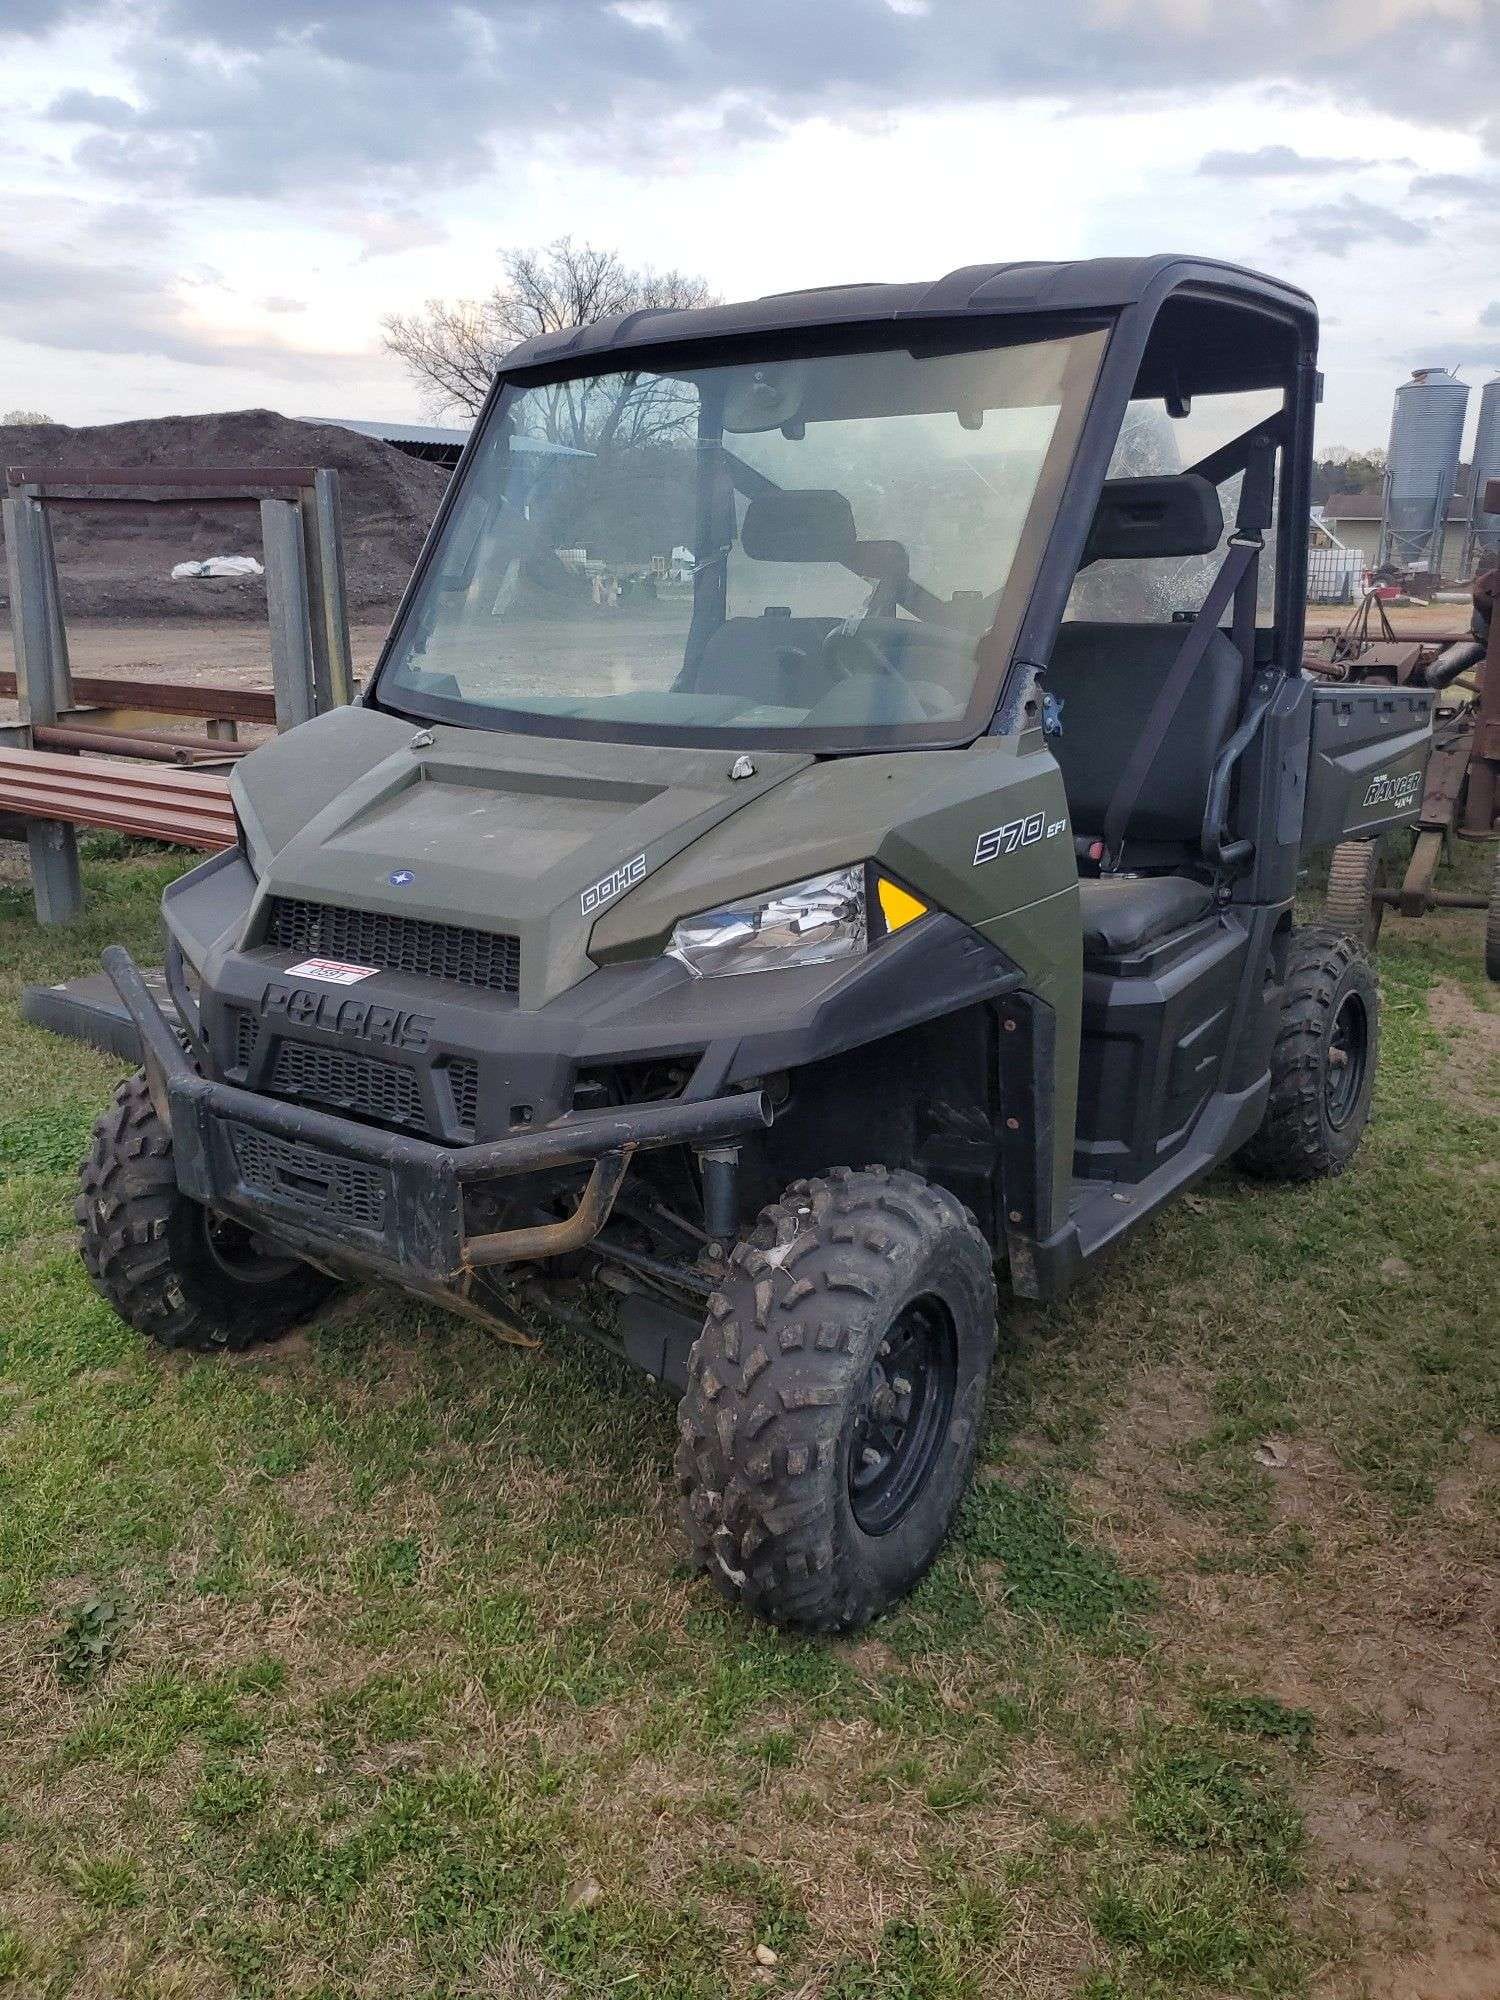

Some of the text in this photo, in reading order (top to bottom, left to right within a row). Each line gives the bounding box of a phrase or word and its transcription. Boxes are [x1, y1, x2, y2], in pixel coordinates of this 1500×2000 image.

[1362, 771, 1421, 807] RANGER
[972, 811, 1066, 866] 570 EFI
[581, 853, 646, 916] DOHC
[260, 983, 436, 1054] POLARIS
